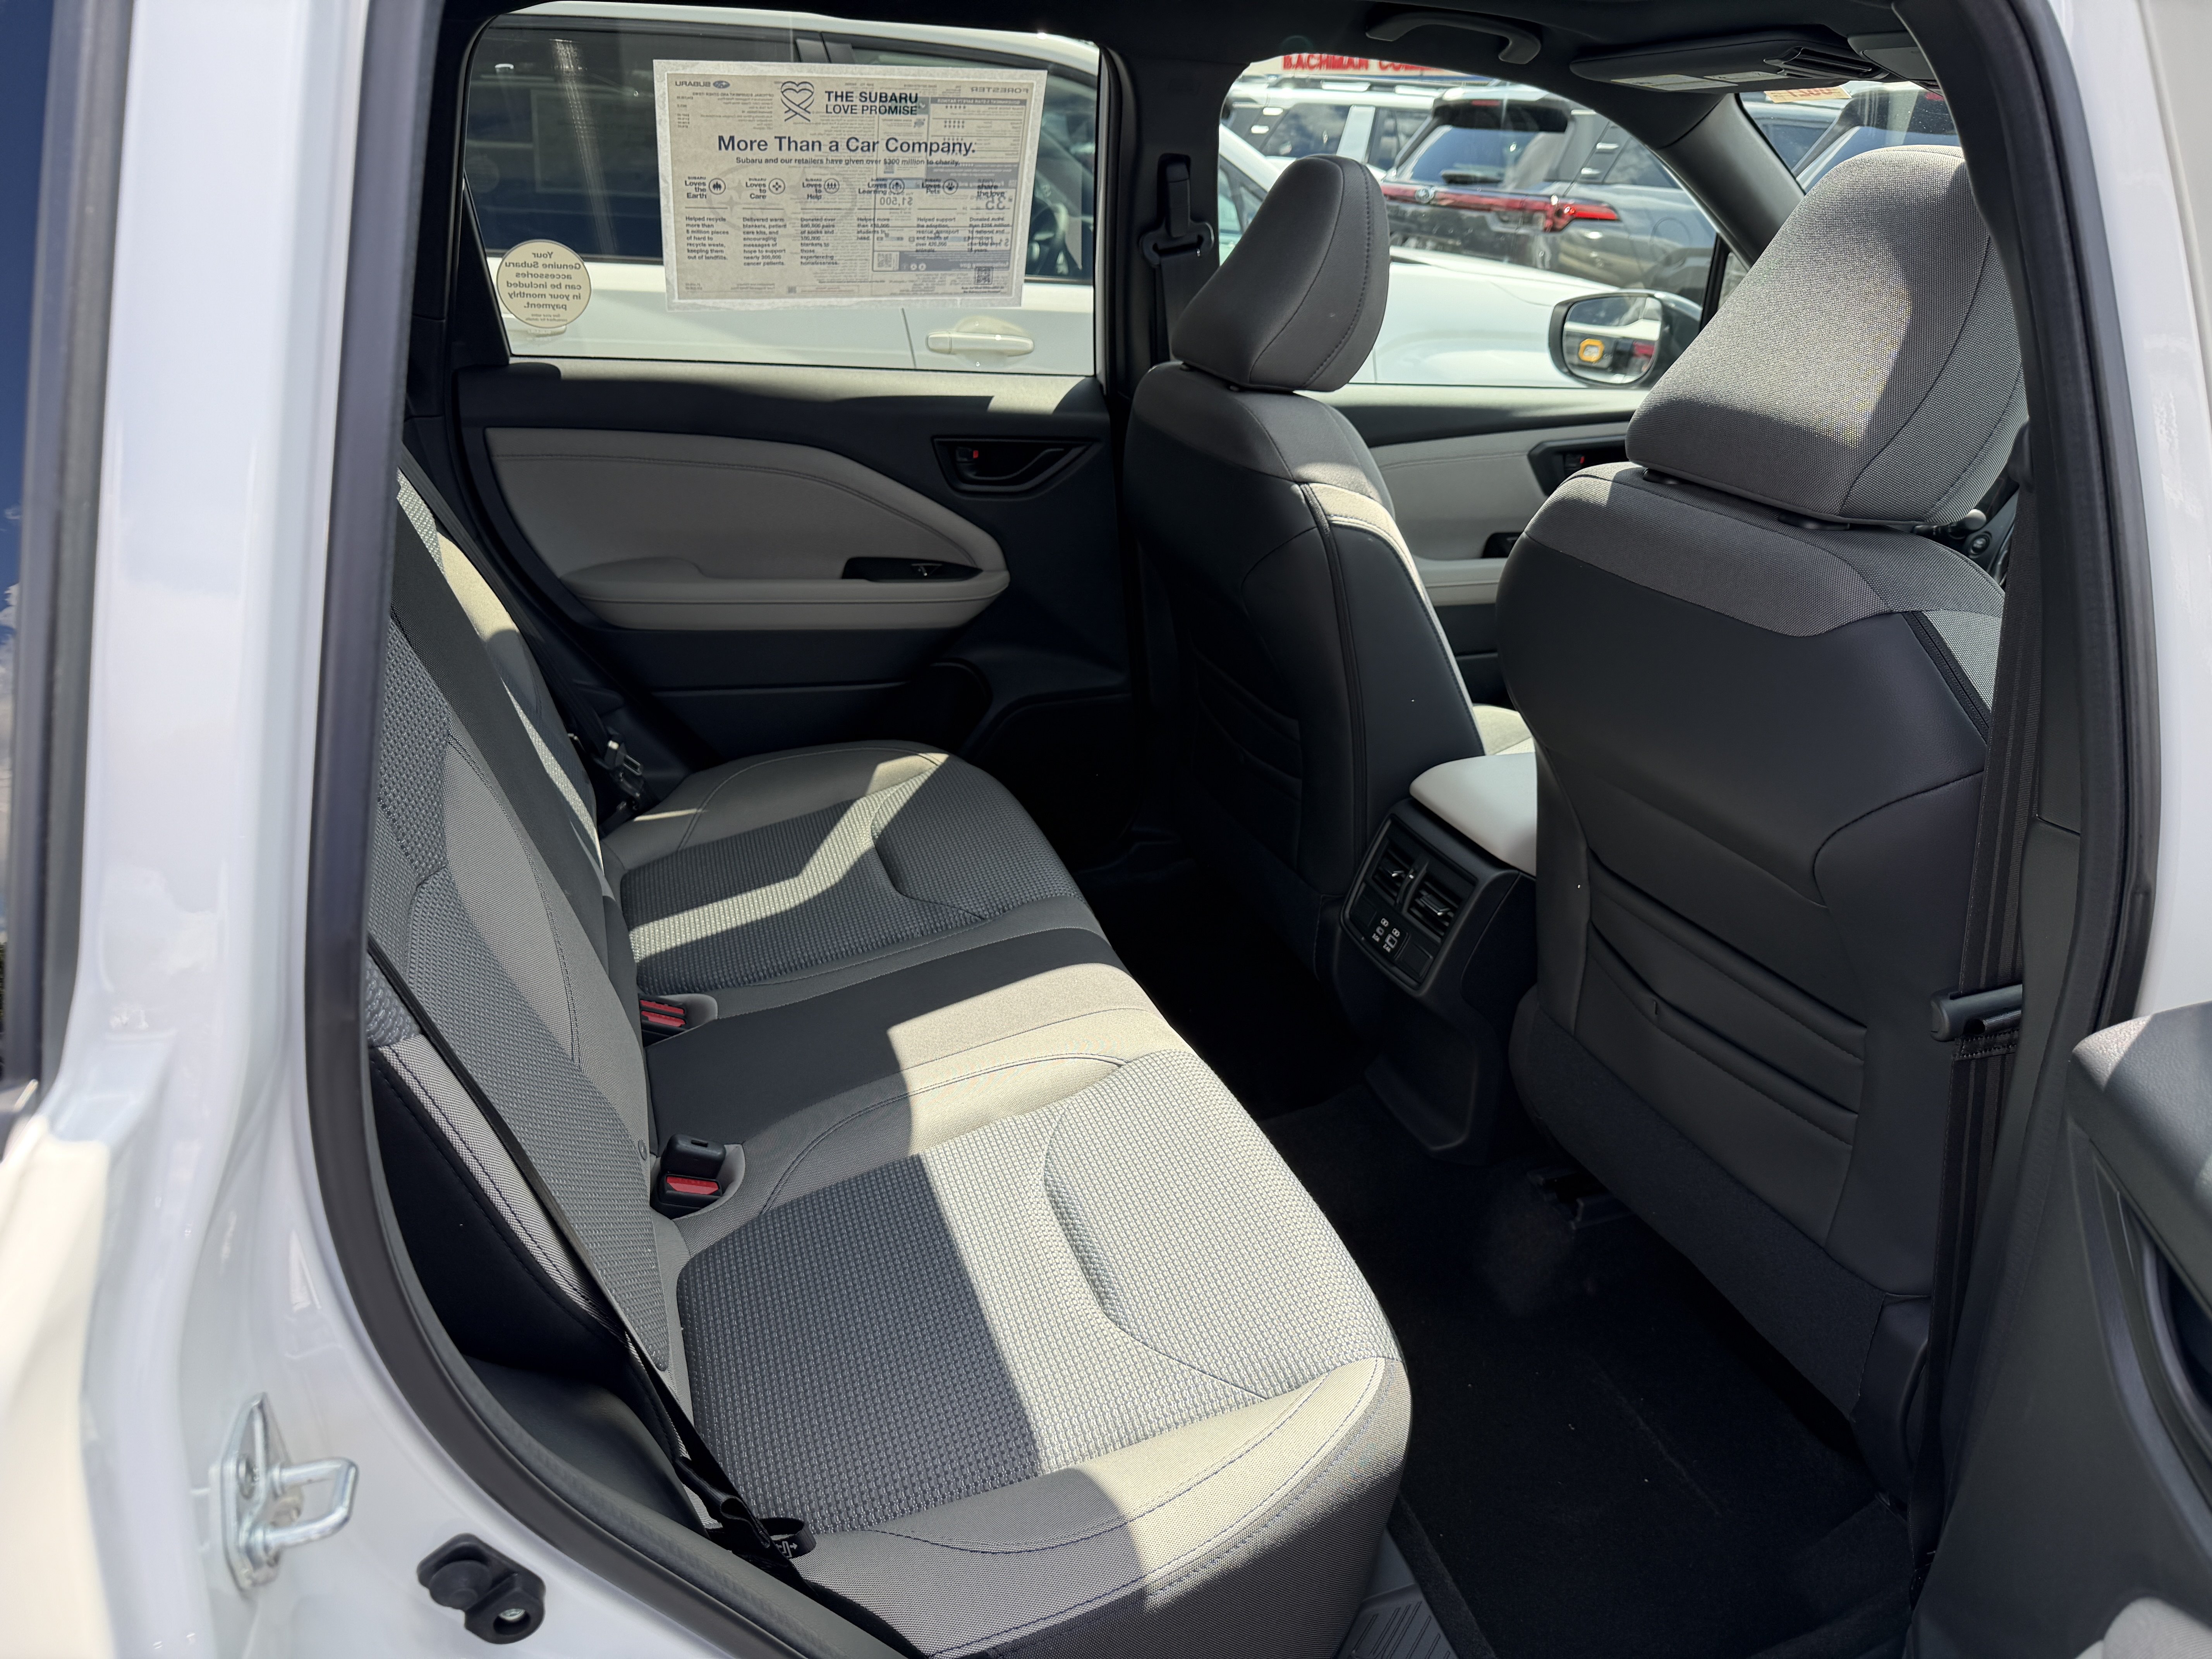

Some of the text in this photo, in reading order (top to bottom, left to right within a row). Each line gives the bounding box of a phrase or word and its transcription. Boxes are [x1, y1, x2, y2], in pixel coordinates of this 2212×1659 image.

[825, 91, 918, 103] THE SUBARU
[826, 104, 917, 115] LOVE PROMISE
[718, 135, 768, 151] More
[774, 136, 822, 152] Than
[828, 140, 839, 152] a
[846, 137, 879, 152] Car
[886, 137, 975, 156] Company.
